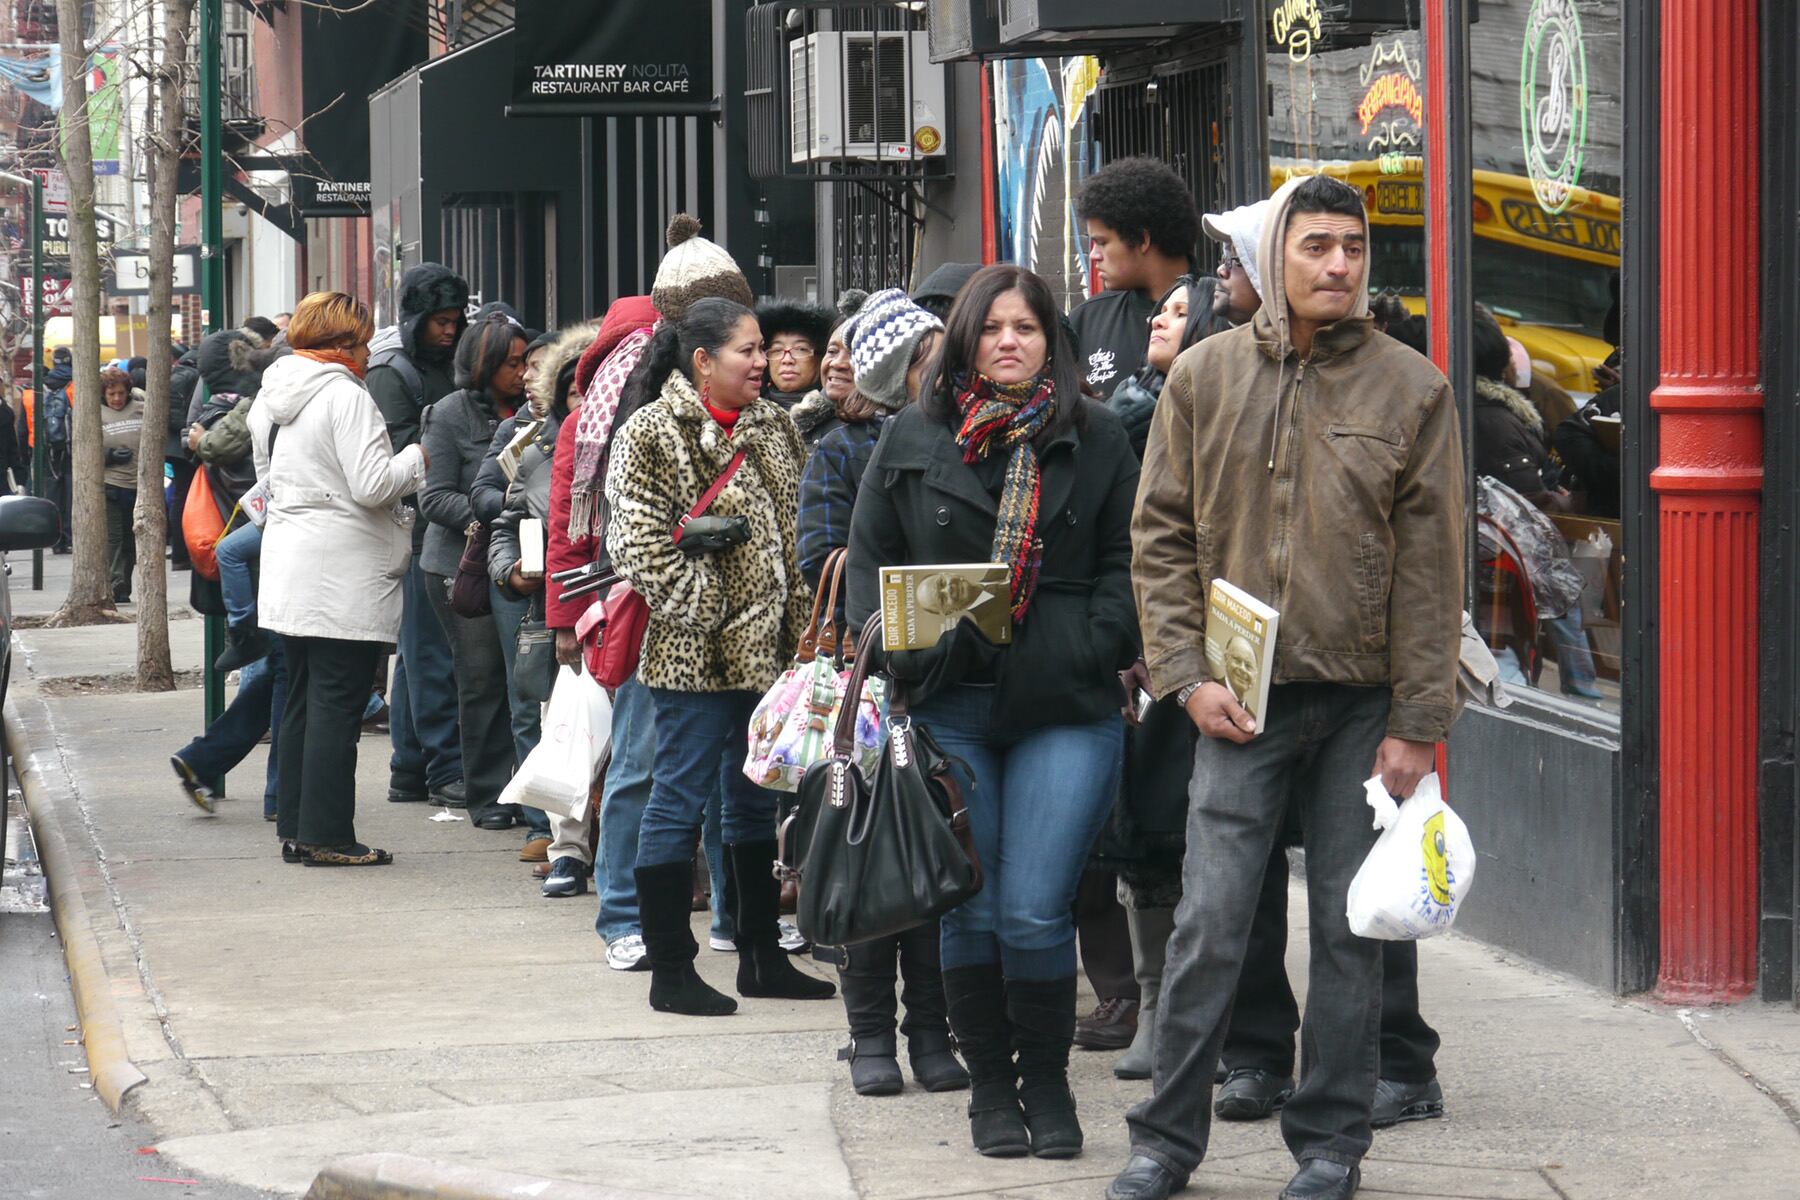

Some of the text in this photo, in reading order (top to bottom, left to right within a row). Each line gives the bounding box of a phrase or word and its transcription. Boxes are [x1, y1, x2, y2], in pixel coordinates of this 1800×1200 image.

[534, 63, 689, 78] TARTINERY NOLITA
[532, 78, 689, 94] RESTAURANT BAR CAFÉ
[316, 182, 371, 192] TARTINER
[905, 574, 914, 609] PERDER
[887, 588, 899, 625] MACEDO
[907, 618, 916, 645] NADA
